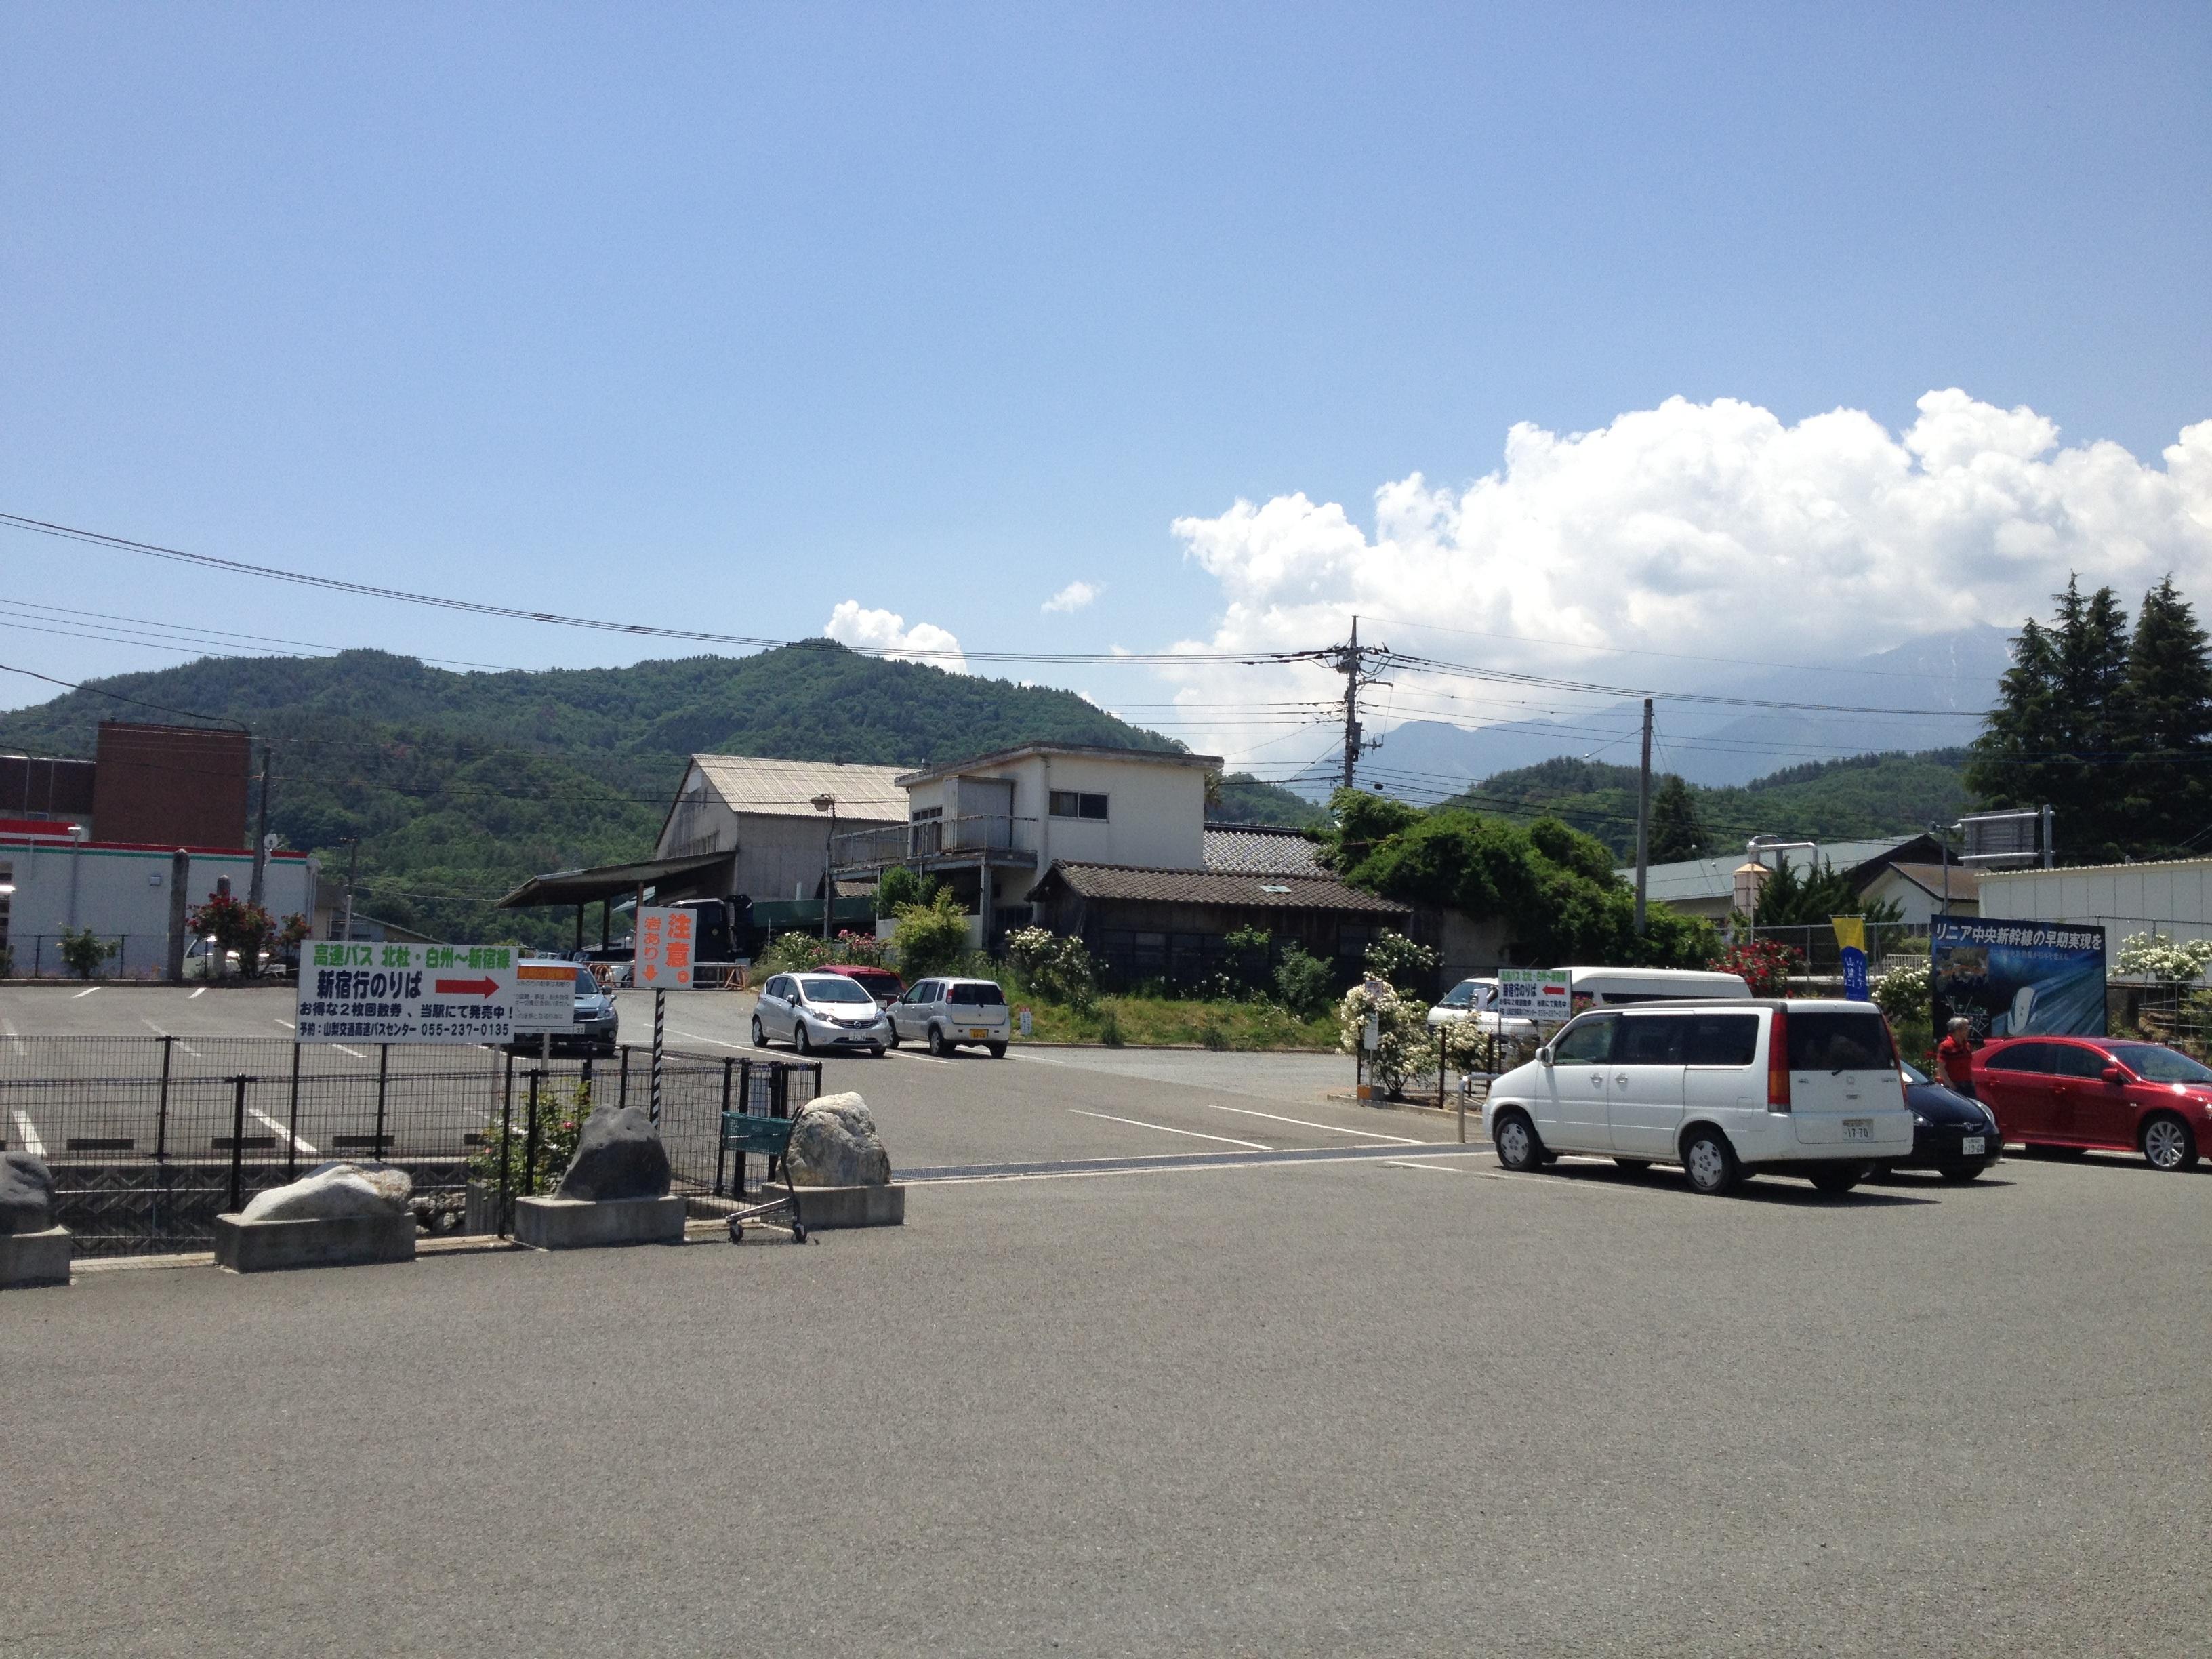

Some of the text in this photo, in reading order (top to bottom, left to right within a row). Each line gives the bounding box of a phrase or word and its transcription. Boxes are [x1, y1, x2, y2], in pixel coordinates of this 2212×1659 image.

[643, 916, 662, 961] 岩あり
[1936, 923, 2102, 950] リニア中央新幹線の早期実現を
[314, 943, 373, 966] 高速バス
[316, 969, 423, 999] 新宿行のりば
[421, 1023, 509, 1036] 055-237-0135
